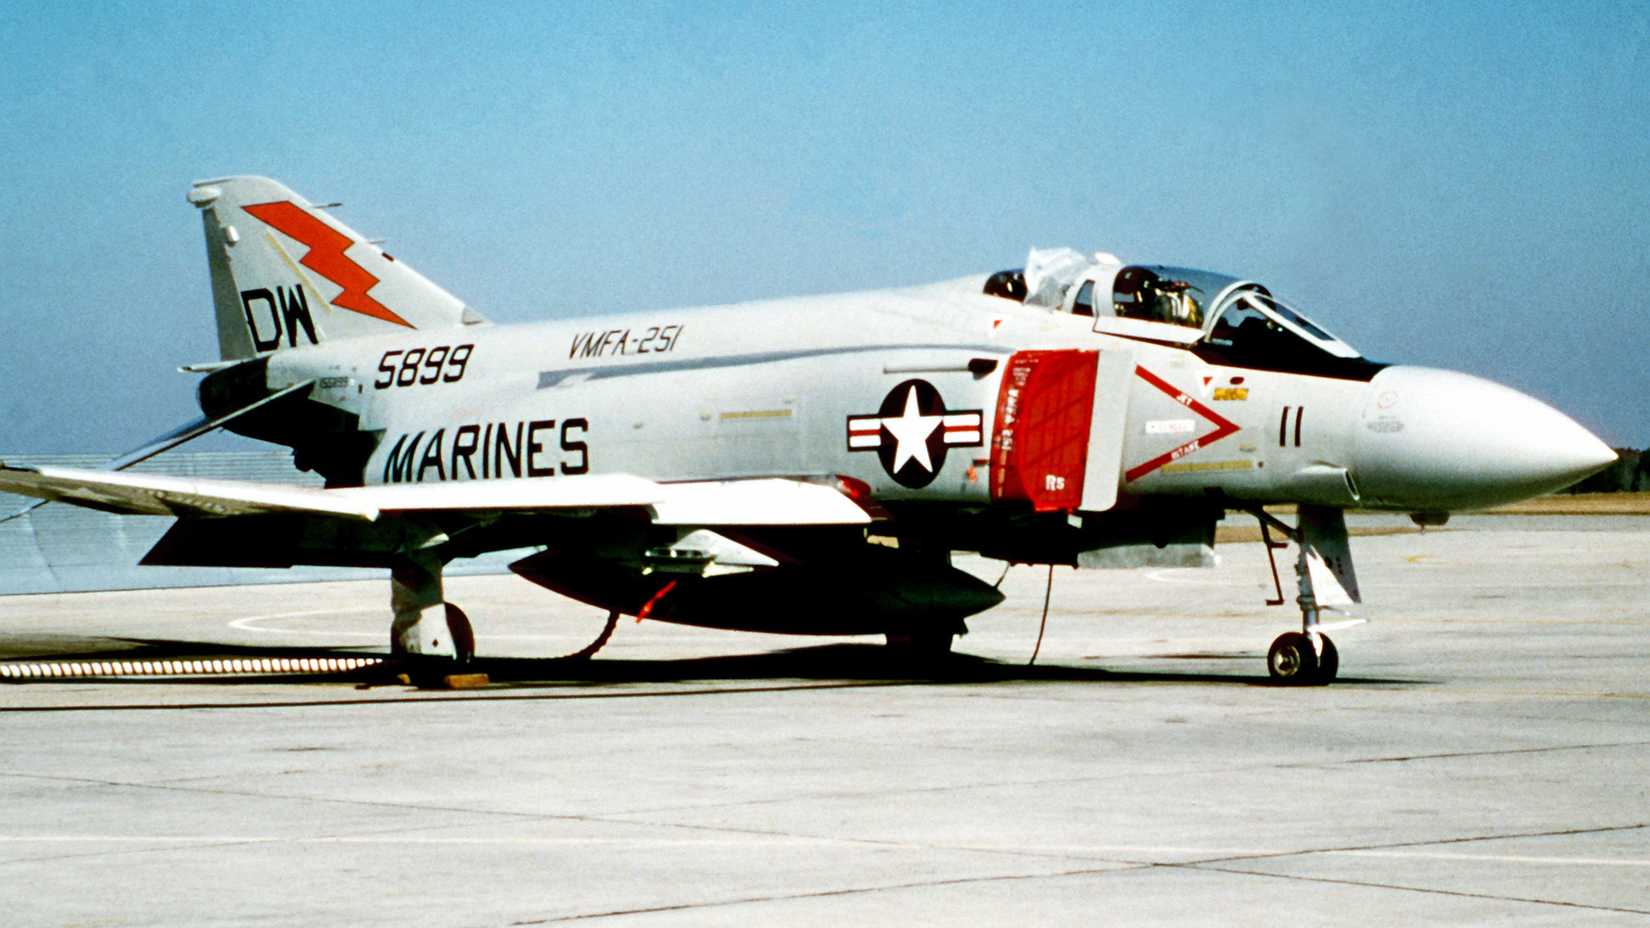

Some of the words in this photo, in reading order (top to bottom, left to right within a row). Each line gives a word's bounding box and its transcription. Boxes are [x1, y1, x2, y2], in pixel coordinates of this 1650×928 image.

[241, 283, 318, 352] DW
[569, 324, 685, 360] VMFA-251
[374, 344, 474, 391] 5899
[1279, 405, 1304, 447] 11
[383, 417, 589, 485] MARINES
